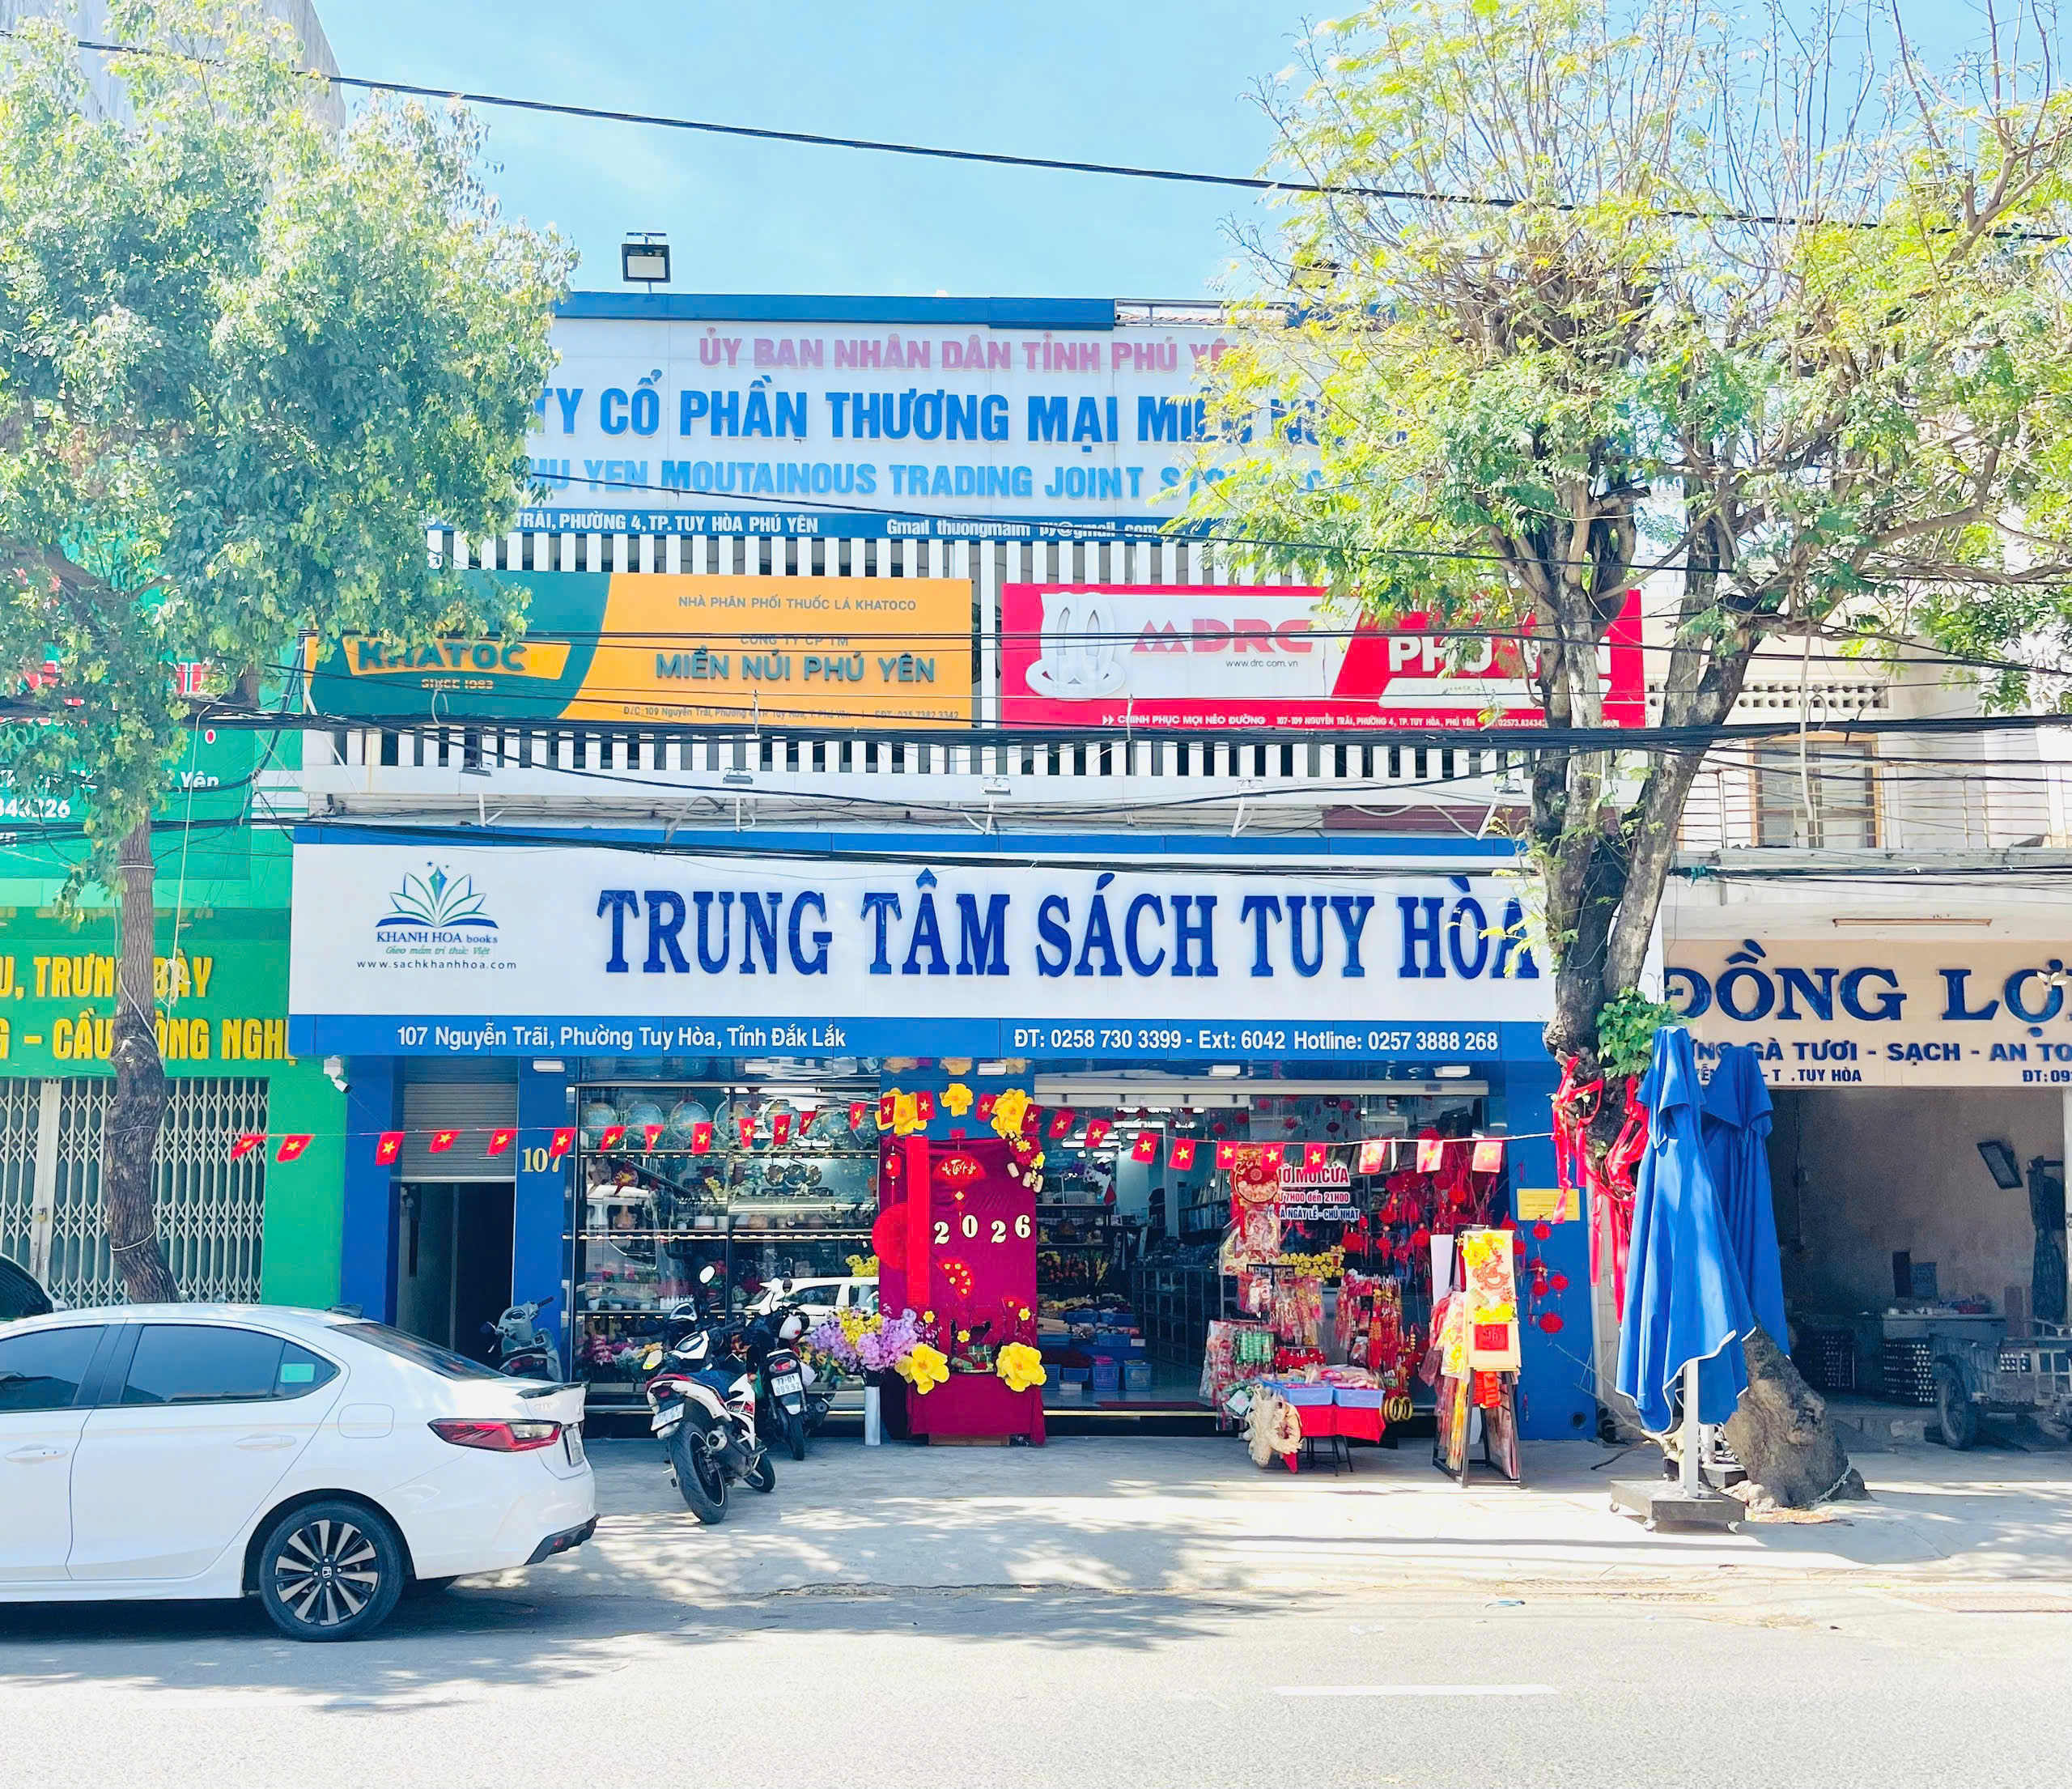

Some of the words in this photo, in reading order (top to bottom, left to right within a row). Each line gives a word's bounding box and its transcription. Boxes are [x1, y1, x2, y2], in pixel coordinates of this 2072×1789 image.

[699, 326, 742, 367] ỦY
[754, 338, 824, 369] BAN
[834, 333, 931, 370] NHÂN
[942, 334, 1011, 372] DÂN
[1022, 331, 1101, 372] TỈNH
[1111, 336, 1178, 373] PHÚ
[532, 388, 584, 436] TY
[600, 369, 663, 438] CỔ
[679, 375, 808, 439] PHẦN
[825, 389, 1009, 442] THƯƠNG
[1027, 395, 1119, 453] MẠI
[528, 458, 570, 491] HU
[583, 459, 648, 492] YEN
[660, 460, 877, 495] MOUTAINOUS
[889, 463, 1032, 498] TRADING
[1044, 466, 1144, 500] JOINT
[558, 511, 626, 531] PHƯỜNG
[631, 515, 647, 533] 4,
[674, 515, 707, 533] TUY
[711, 513, 743, 533] HÒA
[747, 512, 781, 534] PHÚ
[784, 513, 818, 535] YÊN
[678, 593, 707, 608] NHÀ
[710, 595, 746, 609] PHÂN
[750, 593, 782, 610] PHỐI
[786, 594, 830, 611] THUỐC
[834, 596, 851, 610] LÁ
[856, 599, 917, 611] KHATOCO
[1191, 618, 1314, 654] DRC
[656, 644, 729, 680] MIỀN
[741, 648, 792, 681] NÚI
[803, 650, 864, 682] PHÚ
[877, 652, 936, 682] YÊN
[421, 678, 461, 690] SINCE
[1152, 716, 1180, 727] PHỤC
[1182, 716, 1203, 726] MỌI
[1228, 713, 1266, 725] ĐƯỜNG
[1410, 717, 1423, 727] TUY
[1445, 716, 1459, 727] PHÚ
[1461, 716, 1475, 728] YÊN
[0, 798, 71, 819] 43226
[596, 890, 834, 975] TRUNG
[862, 868, 1011, 976] TÂM
[1035, 873, 1219, 978] SÁCH
[1240, 894, 1375, 978] TUY
[1395, 875, 1539, 979] HÒA
[376, 931, 428, 943] KHANH
[431, 931, 462, 943] HOA
[466, 934, 499, 944] books
[33, 953, 122, 998] TRƯN
[154, 949, 213, 998] BÀY
[357, 959, 517, 970] www.sachkhanhhoa.com
[1664, 939, 1909, 1023] ĐỒNG
[53, 1007, 115, 1060] CẦU
[155, 1010, 210, 1060] ÔNG
[397, 1026, 430, 1046] 107
[435, 1021, 507, 1051] Nguyễn
[511, 1026, 555, 1049] Trãi,
[560, 1024, 633, 1051] Phường
[640, 1027, 675, 1052] Tuy
[678, 1026, 723, 1051] Hòa,
[727, 1025, 767, 1047] Tỉnh
[770, 1024, 808, 1048] Đắk
[812, 1024, 847, 1048] Lắk
[1013, 1028, 1045, 1048] ĐT:
[1050, 1028, 1096, 1049] 0258
[1099, 1029, 1132, 1049] 730
[1137, 1029, 1182, 1050] 3399
[1198, 1030, 1236, 1050] Ext:
[1240, 1030, 1286, 1051] 6042
[1293, 1030, 1363, 1051] Hotline:
[1367, 1030, 1412, 1052] 0257
[1415, 1031, 1460, 1052] 3888
[1463, 1031, 1498, 1052] 268
[1792, 1039, 1858, 1061] TƯƠI
[1887, 1042, 1960, 1065] SẠCH
[1989, 1043, 2027, 1062] AN
[1832, 1065, 1862, 1082] HÒA
[1320, 1162, 1349, 1183] CỬA
[1306, 1190, 1322, 1202] đến
[1324, 1192, 1349, 1203] 21H00
[1323, 1206, 1338, 1219] CHỦ
[1340, 1207, 1360, 1222] NHẬT
